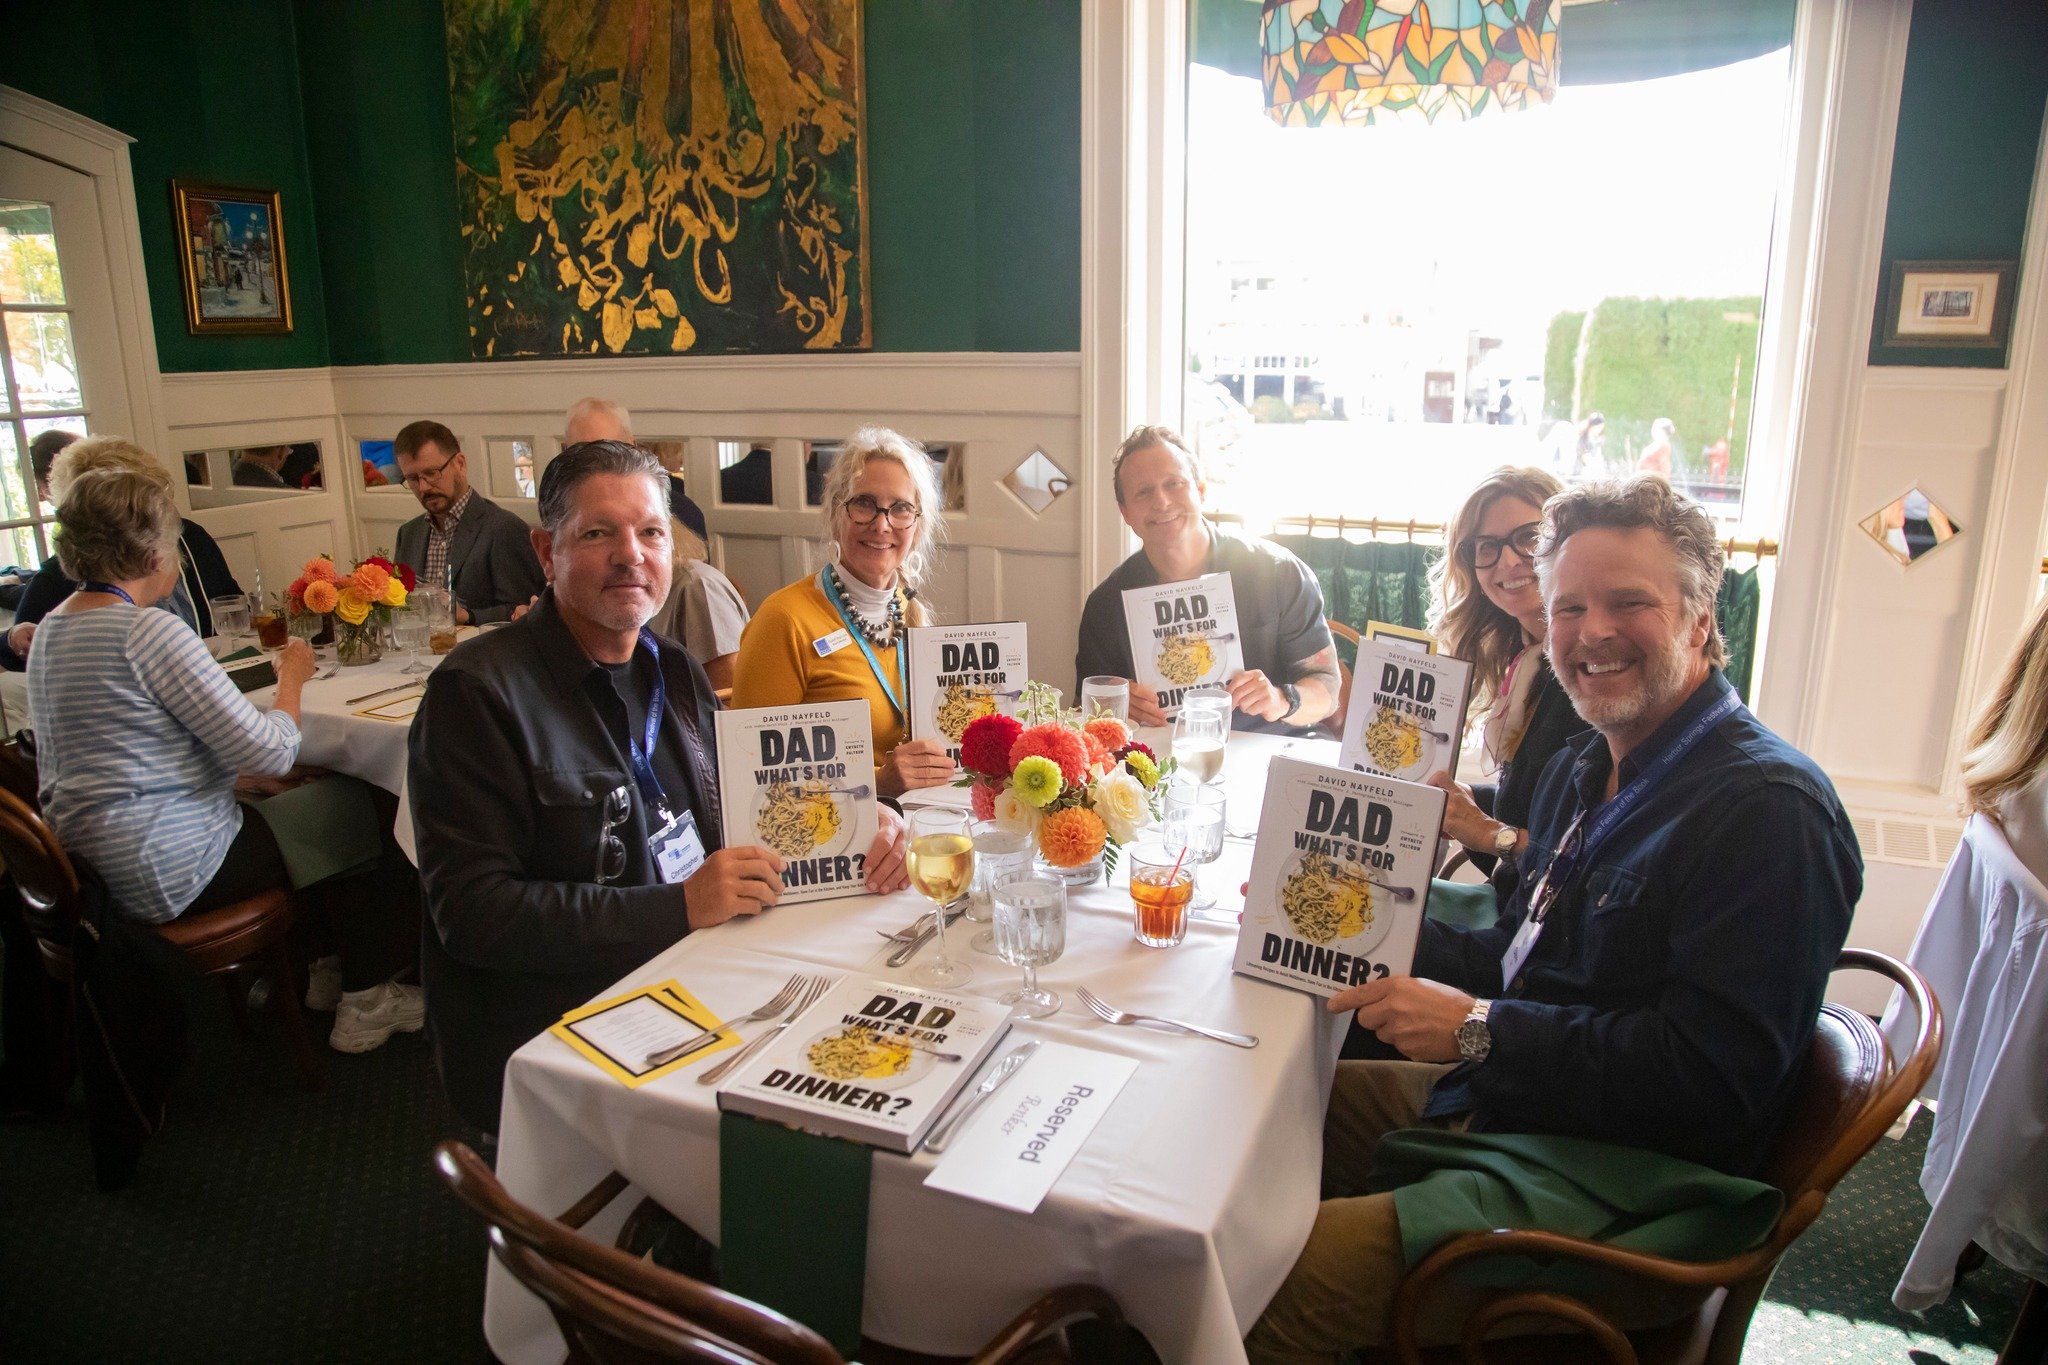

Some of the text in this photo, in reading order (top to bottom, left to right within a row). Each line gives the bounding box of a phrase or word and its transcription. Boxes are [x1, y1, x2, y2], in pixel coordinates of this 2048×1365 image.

[1176, 585, 1204, 593] NAYFELD
[1154, 594, 1211, 626] DAD,
[1152, 619, 1218, 639] WHAT'S FOR
[941, 642, 1001, 673] DAD,
[1388, 652, 1407, 661] DAVID
[1409, 657, 1437, 669] NAYFELD
[936, 672, 1006, 687] WHAT'S FOR
[1380, 662, 1436, 706] DAD,
[652, 688, 661, 702] Book
[1373, 692, 1437, 722] WHAT'S FOR
[762, 714, 789, 723] DAVID
[792, 711, 831, 720] NAYFELD
[1681, 723, 1705, 746] Springs
[1701, 704, 1724, 725] Festival
[760, 725, 838, 766] DAD,
[635, 755, 646, 770] Book
[754, 762, 847, 786] WHAT'S FOR
[1318, 775, 1347, 787] DAVID
[1350, 782, 1394, 798] NAYFELD
[1600, 808, 1621, 828] Festival
[1619, 800, 1627, 809] of
[1624, 792, 1636, 803] the
[1633, 777, 1651, 794] Book
[1304, 789, 1393, 850] DAD,
[1294, 831, 1396, 872] WHAT'S FOR
[671, 855, 699, 880] Christopher
[782, 853, 867, 888] NNER?
[1260, 932, 1391, 988] DINNER?
[887, 988, 916, 997] DAVID
[918, 994, 963, 1006] NAYFELD
[858, 994, 957, 1032] DAD,
[841, 1014, 909, 1035] WHAT'S
[910, 1029, 948, 1044] FOR
[761, 1068, 912, 1117] DINNER?
[1018, 1085, 1095, 1164] Reserved
